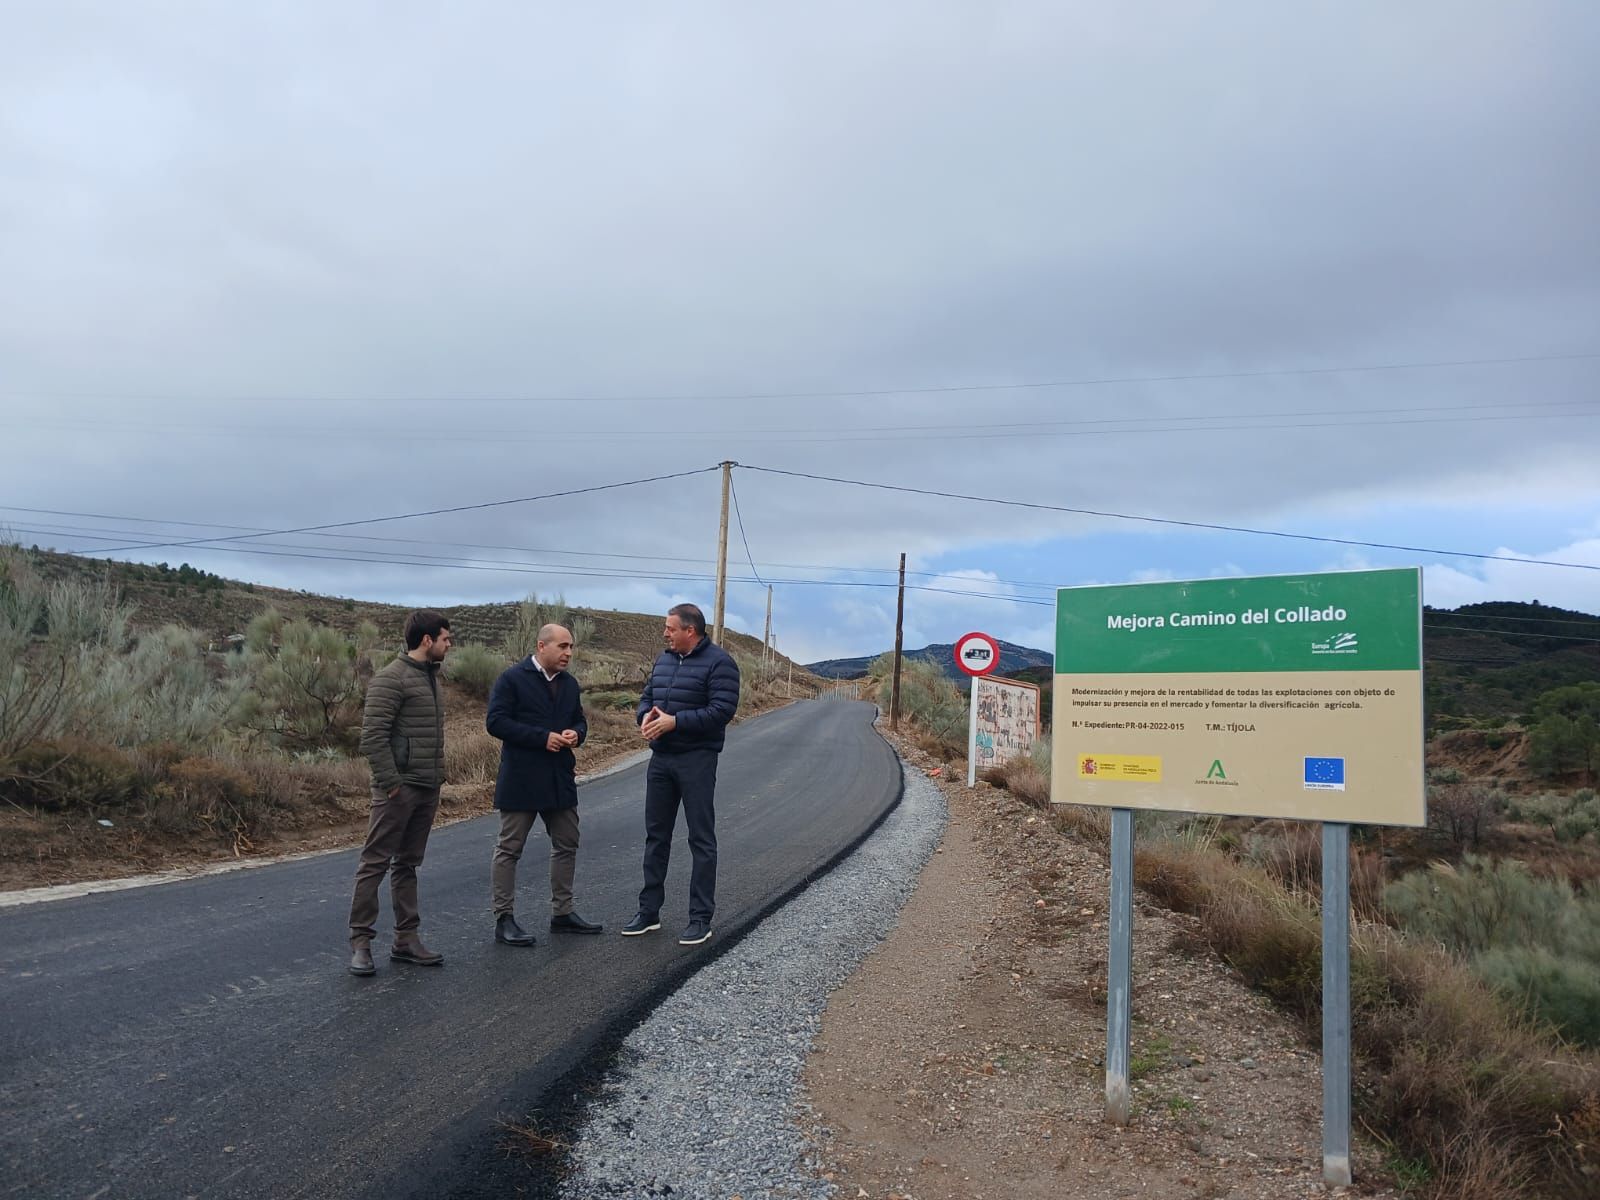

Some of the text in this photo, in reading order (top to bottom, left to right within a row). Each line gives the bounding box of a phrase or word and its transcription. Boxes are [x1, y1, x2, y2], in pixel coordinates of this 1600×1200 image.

[1107, 606, 1347, 632] Mejora Camino del Collado
[1071, 688, 1122, 696] Modernización
[1130, 688, 1156, 697] mejora
[1157, 688, 1167, 696] de
[1168, 688, 1176, 696] la
[1177, 688, 1224, 696] rentabilidad
[1225, 688, 1235, 696] de
[1237, 688, 1259, 696] todas
[1261, 688, 1273, 696] las
[1275, 688, 1332, 698] explotaciones
[1354, 688, 1381, 698] objeto
[1384, 688, 1395, 696] de
[1113, 700, 1148, 709] presencia
[1161, 700, 1168, 708] el
[1170, 700, 1203, 708] mercado
[1205, 702, 1209, 710] y
[1211, 700, 1248, 708] fomentar
[1249, 701, 1257, 709] la
[1259, 700, 1319, 709] diversificación
[1324, 701, 1363, 710] agrícola.
[1125, 721, 1185, 731] PR-04-2022-015
[1226, 722, 1256, 733] TÍJOLA
